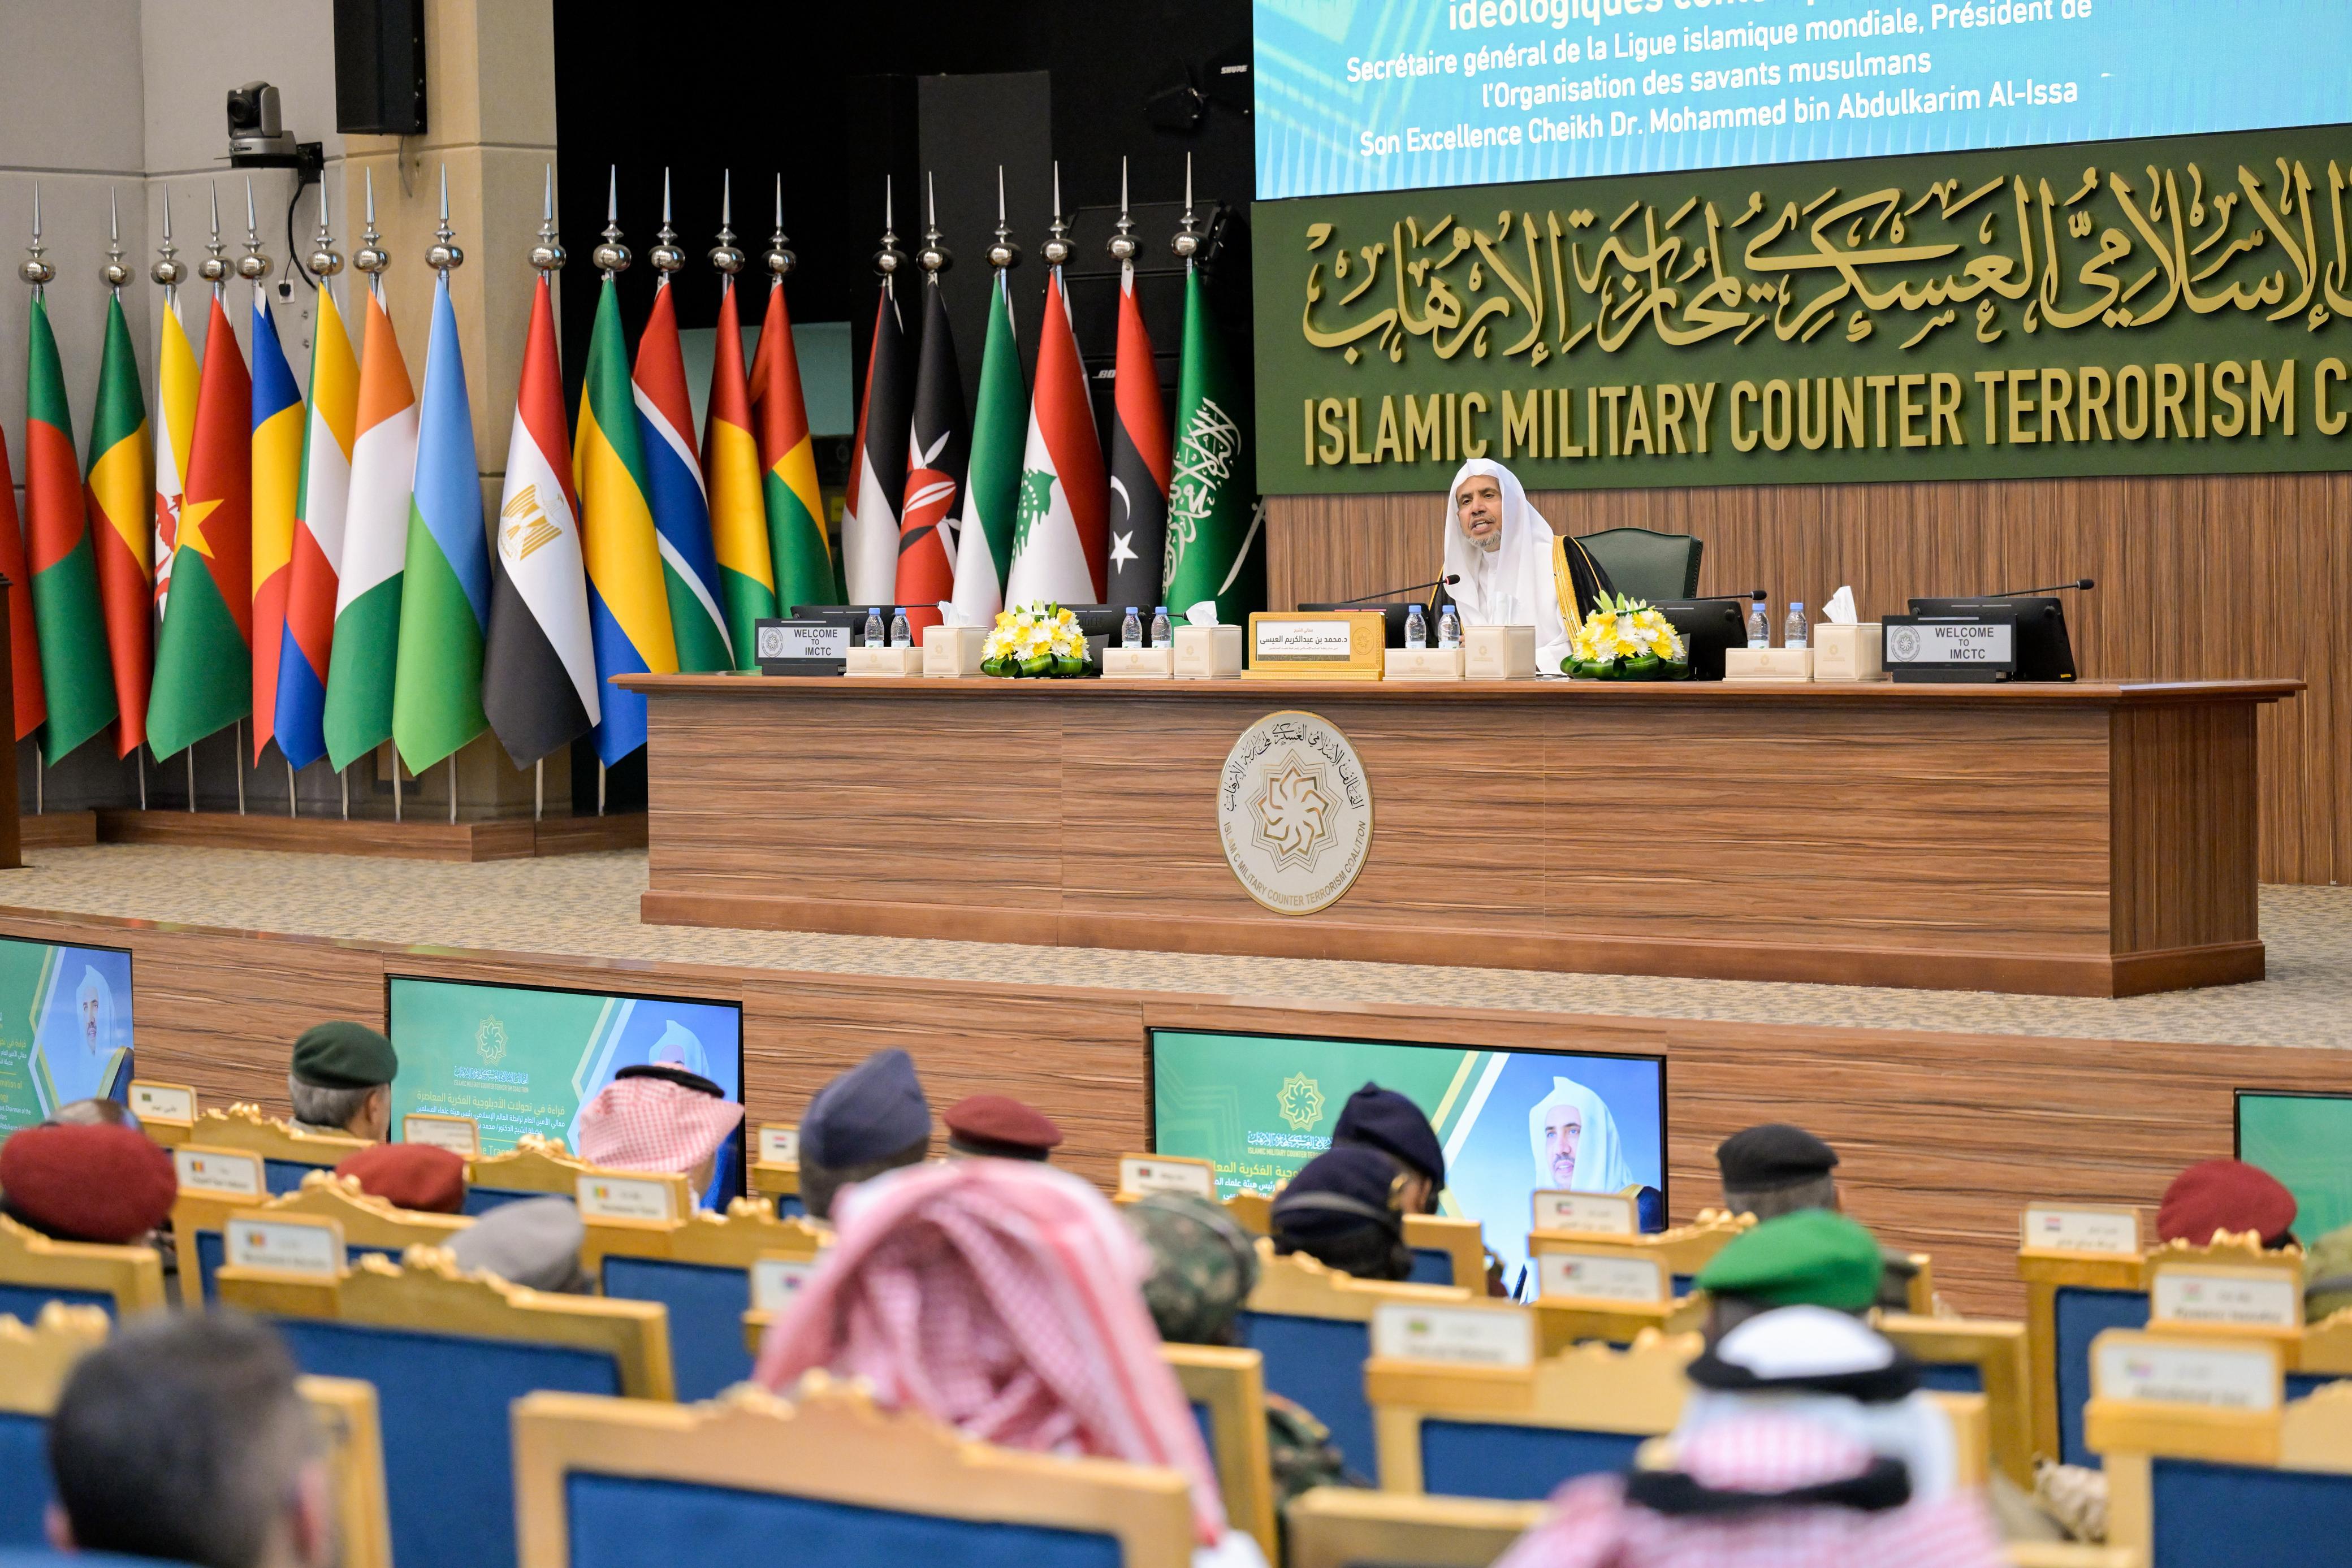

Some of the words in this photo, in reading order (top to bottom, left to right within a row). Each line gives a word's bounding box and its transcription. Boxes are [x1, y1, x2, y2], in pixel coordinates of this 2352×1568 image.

[1347, 53, 1458, 83] Secrétaire
[1463, 40, 1547, 77] général
[1553, 37, 1580, 64] de
[1587, 36, 1607, 60] la
[1615, 33, 1677, 62] Ligue
[1684, 24, 1798, 52] islamique
[1806, 7, 1924, 42] mondiale,
[1931, 0, 2053, 29] Président
[2061, 0, 2092, 19] de
[1482, 73, 1636, 111] l'Organisation
[1642, 69, 1683, 96] des
[1690, 62, 1781, 92] savants
[1789, 52, 1932, 83] musulmans
[1360, 130, 1400, 157] Son
[1407, 123, 1522, 152] Excellence
[1528, 113, 1603, 144] Cheikh
[1611, 111, 1644, 137] Dr.
[1650, 98, 1787, 134] Mohammed
[1795, 97, 1830, 123] bin
[1838, 88, 1981, 118] Abdulkarim
[1988, 79, 2078, 108] Al-Issa
[1093, 369, 1117, 379] BO
[1304, 391, 1489, 466] ISLAMIC
[1502, 382, 1720, 458] MILITARY
[1730, 372, 1964, 452] COUNTER
[1974, 358, 2295, 445] TERRORISM
[794, 629, 838, 638] WELCOME
[1935, 627, 1994, 638] WELCOME
[1260, 635, 1283, 644] العيسى
[805, 647, 832, 656] IMCTC
[1950, 648, 1986, 660] IMCTC
[1223, 821, 1240, 863] ISLAMIC
[1237, 860, 1268, 895] MILITARY
[1268, 889, 1304, 906] COUNTER
[1305, 870, 1347, 904] TERRORISM
[1344, 820, 1366, 873] COALITION
[417, 1090, 446, 1102] المعاصرة
[447, 1093, 470, 1106] الفكرية
[507, 1099, 533, 1114] تحولات
[534, 1104, 546, 1117] في
[547, 1104, 565, 1117] قراءة
[461, 1110, 472, 1118] رئيس
[536, 1117, 550, 1127] الأمين
[551, 1119, 565, 1129] معالي
[1213, 1160, 1236, 1173] المعا
[1239, 1163, 1272, 1177] الفكرية
[1225, 1178, 1242, 1186] علماء
[1243, 1179, 1257, 1189] هيئة
[1259, 1181, 1275, 1192] رئيس
